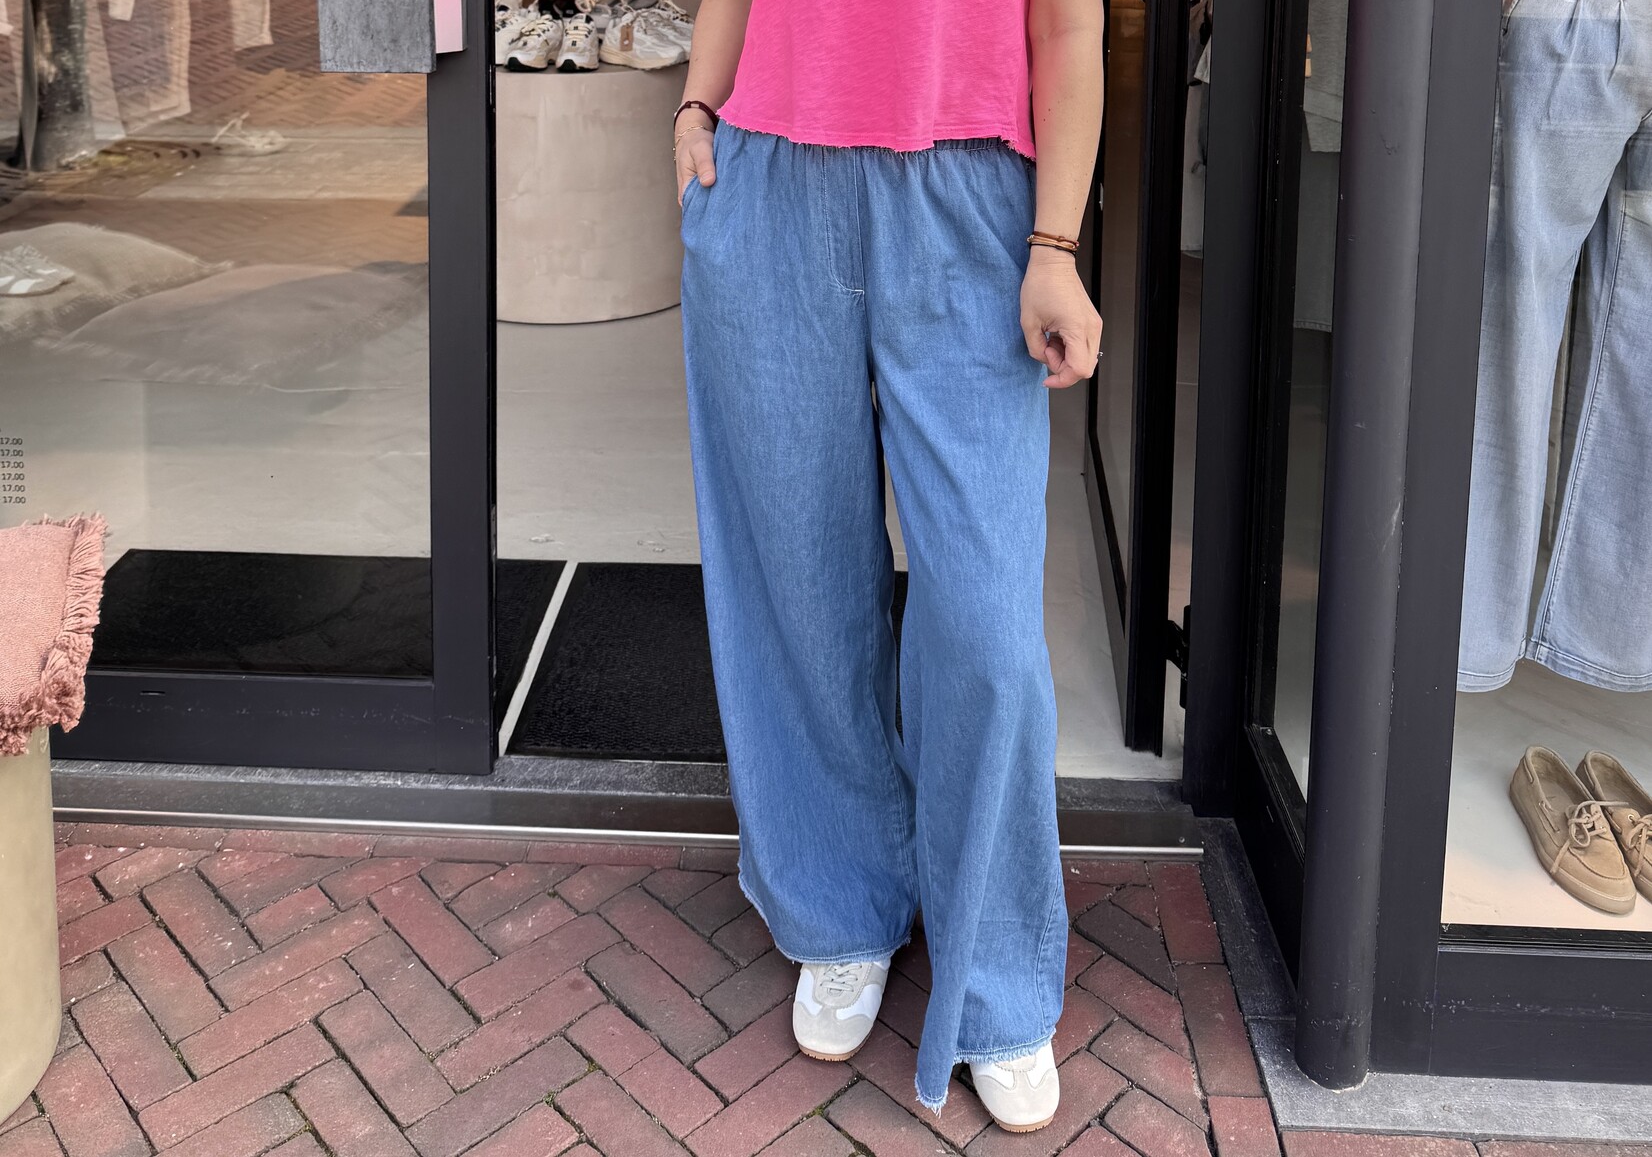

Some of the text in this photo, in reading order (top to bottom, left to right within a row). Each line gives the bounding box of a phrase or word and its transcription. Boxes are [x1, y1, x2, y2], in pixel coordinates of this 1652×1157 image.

[0, 449, 24, 457] 17.00
[1, 461, 25, 469] 17.00
[2, 473, 25, 481] 17.00
[2, 484, 26, 492] 17.00
[3, 496, 26, 504] 17.00
